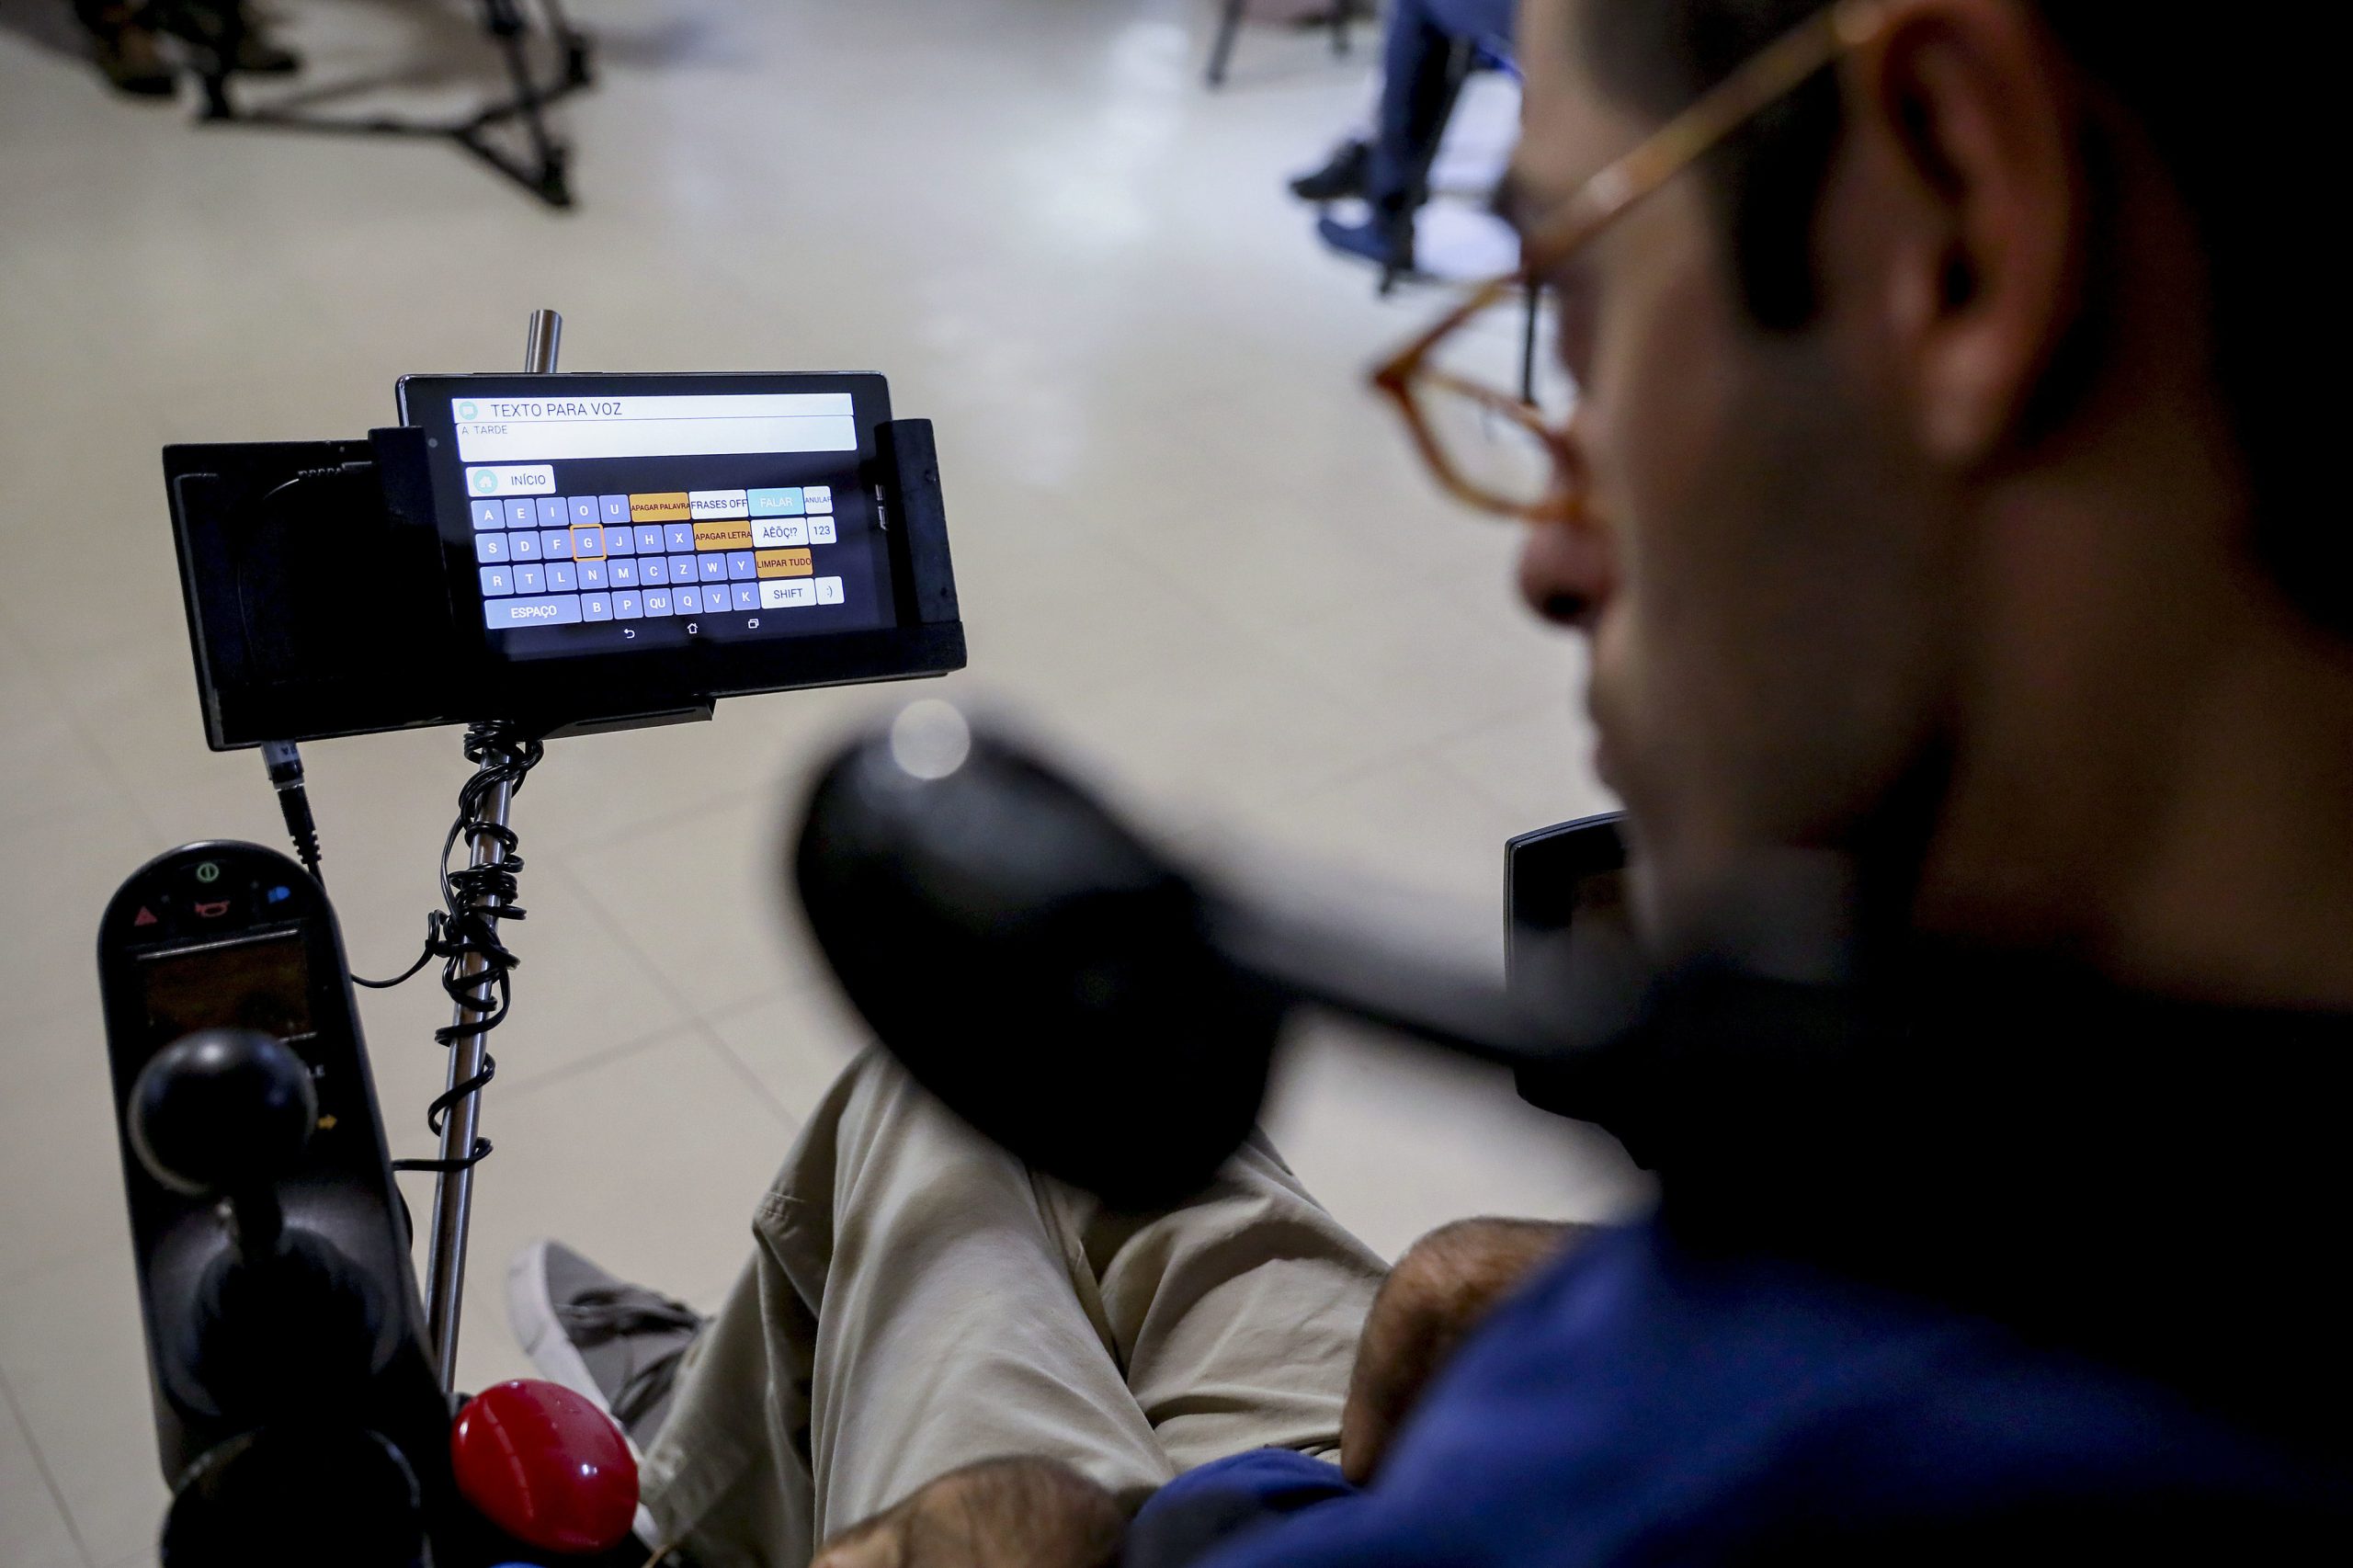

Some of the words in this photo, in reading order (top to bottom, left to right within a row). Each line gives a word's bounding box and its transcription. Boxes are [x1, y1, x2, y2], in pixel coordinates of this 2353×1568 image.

[490, 403, 542, 417] TEXTO
[547, 402, 587, 416] PARA
[590, 402, 623, 415] VOZ
[461, 426, 470, 435] A
[473, 425, 508, 435] TARDE
[510, 473, 546, 486] INÍCIO
[631, 504, 659, 512] APAGAR
[660, 502, 690, 511] PALAVRA
[690, 499, 728, 510] FRASES
[729, 498, 748, 508] OFF
[760, 497, 793, 508] FALAR
[483, 509, 494, 521] A
[517, 507, 526, 519] E
[579, 506, 589, 516] O
[609, 505, 620, 515] U
[695, 531, 726, 540] APAGAR
[728, 530, 752, 540] LETRA
[813, 525, 831, 536] 123
[584, 538, 593, 549] G
[615, 537, 623, 547] J
[644, 535, 654, 545] H
[675, 533, 684, 543] X
[488, 542, 497, 553] S
[520, 540, 529, 552] D
[552, 540, 562, 550] F
[679, 564, 688, 574] Z
[707, 562, 719, 574] W
[737, 561, 745, 571] Y
[756, 559, 788, 569] LIMPAR
[789, 558, 812, 567] TUDO
[588, 570, 597, 581] N
[618, 568, 630, 579] M
[649, 566, 658, 576] C
[493, 575, 503, 586] R
[525, 574, 534, 585] T
[557, 572, 566, 583] L
[712, 594, 721, 604] V
[742, 591, 751, 602] K
[773, 588, 803, 599] SHIFT
[592, 602, 602, 613] B
[623, 600, 632, 610] P
[649, 597, 666, 608] QU
[683, 596, 692, 608] Q
[511, 605, 557, 619] ESPAÇO
